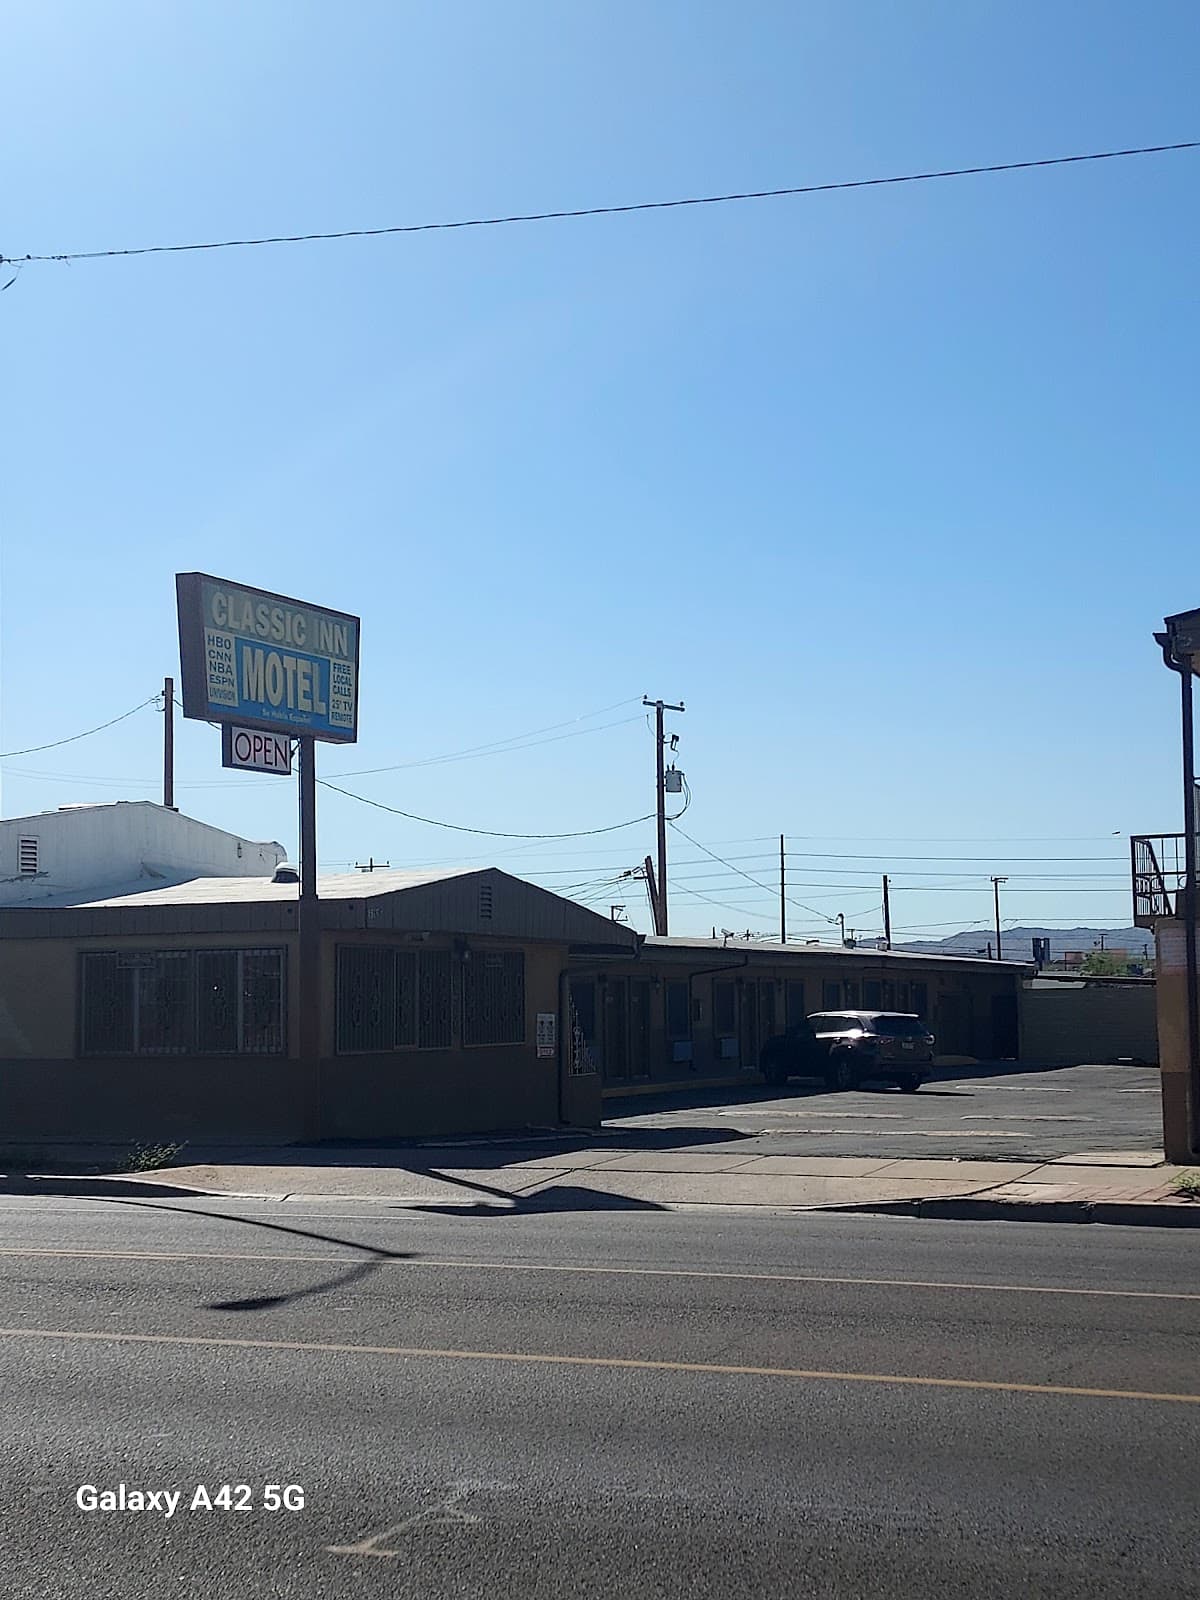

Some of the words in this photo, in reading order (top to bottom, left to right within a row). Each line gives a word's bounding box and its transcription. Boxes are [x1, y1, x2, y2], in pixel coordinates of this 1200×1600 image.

[212, 591, 306, 646] CLASSIC
[316, 618, 348, 657] INN
[207, 634, 231, 650] HBO
[208, 649, 232, 663] CNN
[209, 660, 233, 676] NBA
[333, 662, 351, 676] FREE
[209, 674, 235, 688] ESPN
[242, 645, 327, 716] MOTEL
[333, 673, 352, 687] LOCAL
[332, 684, 351, 698] CALLS
[343, 701, 353, 712] TV
[234, 732, 288, 769] OPEN
